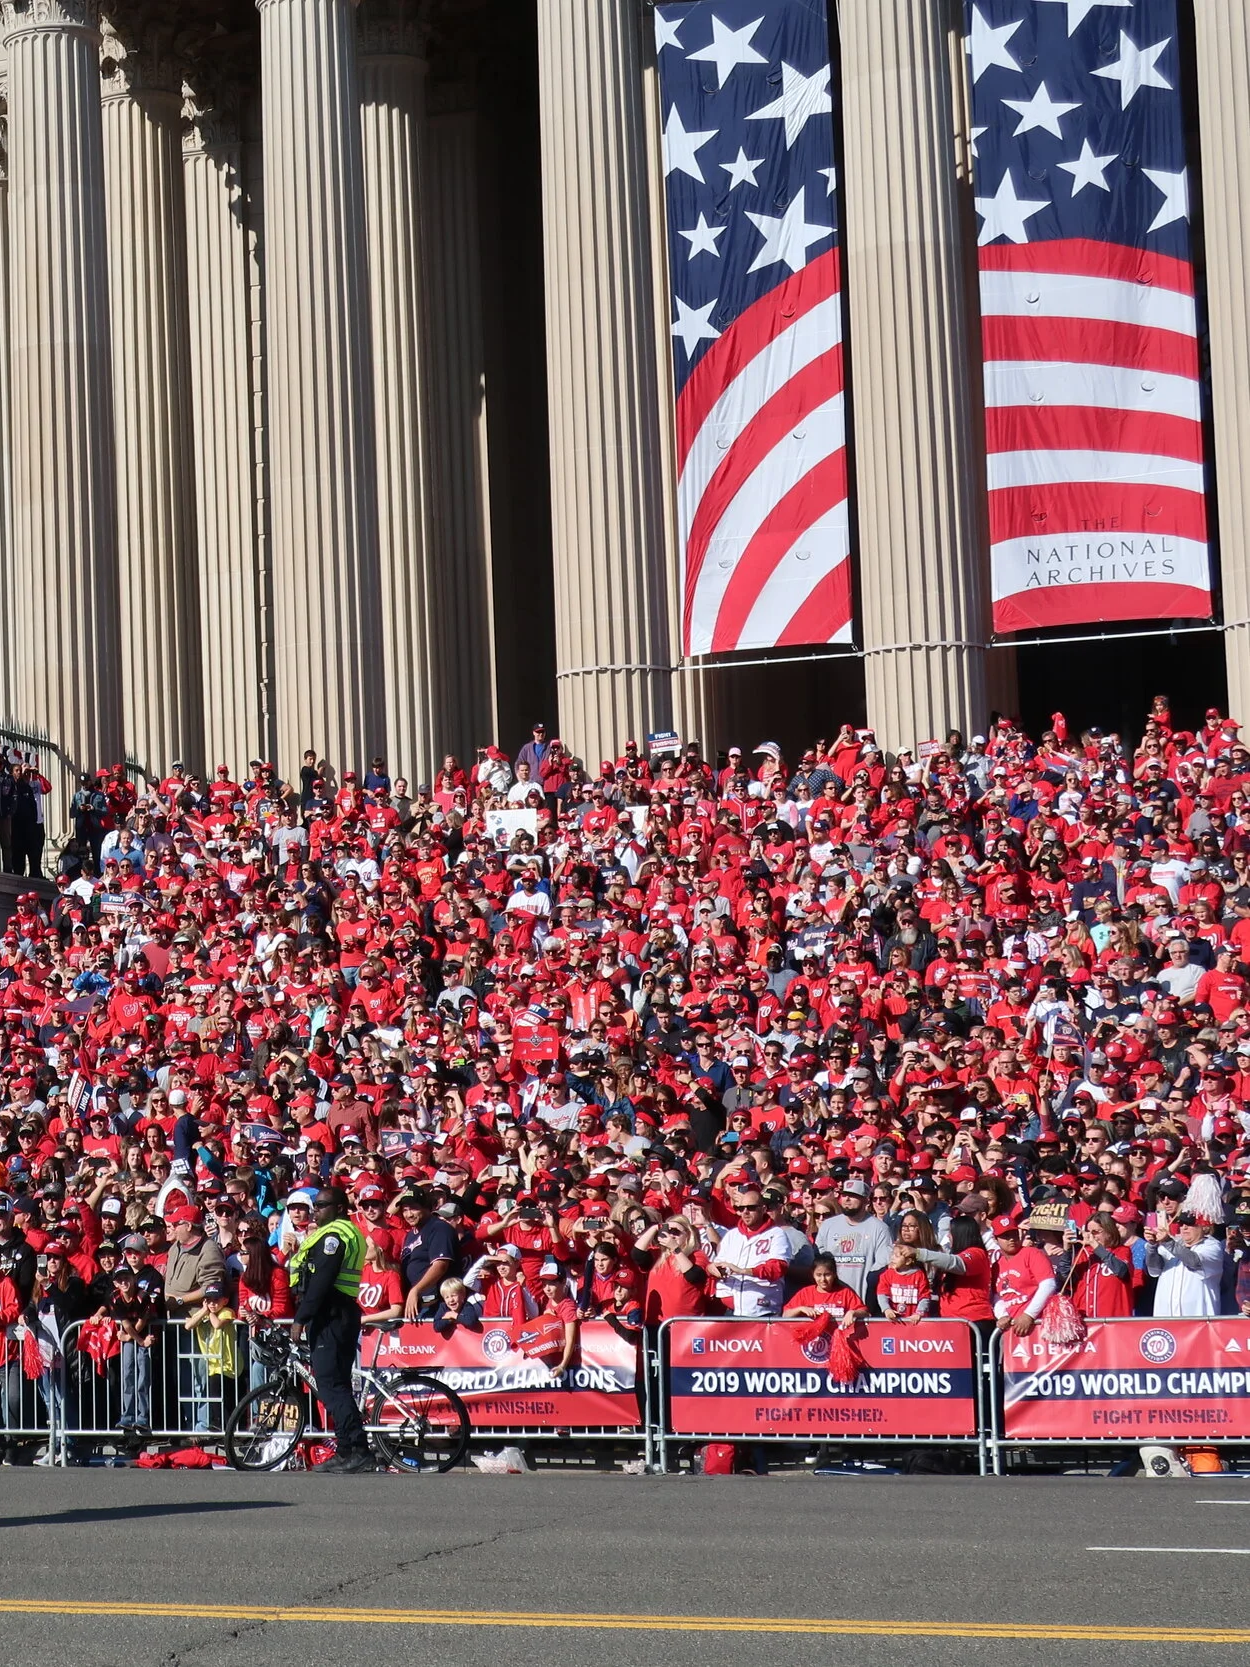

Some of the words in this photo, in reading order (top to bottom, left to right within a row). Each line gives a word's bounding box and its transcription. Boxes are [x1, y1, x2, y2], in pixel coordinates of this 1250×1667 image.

[1081, 516, 1121, 531] THE
[1026, 537, 1174, 565] NATIONAL
[1025, 559, 1175, 588] ARCHIVES
[1030, 1203, 1069, 1217] FIGHT
[409, 1345, 436, 1355] BANK
[710, 1339, 761, 1352] INOVA
[900, 1339, 953, 1353] INOVA
[501, 1368, 617, 1392] CHAMPIONS
[691, 1371, 739, 1394] 2019
[741, 1372, 821, 1394] WORLD
[827, 1372, 952, 1395] CHAMPIONS
[1025, 1374, 1076, 1396] 2019
[1080, 1374, 1162, 1396] WORLD
[485, 1401, 560, 1416] FINISHED.
[755, 1407, 803, 1422] FIGHT
[807, 1407, 888, 1423] FINISHED.
[1093, 1409, 1143, 1424] FIGHT
[1149, 1408, 1234, 1424] FINISHED.
